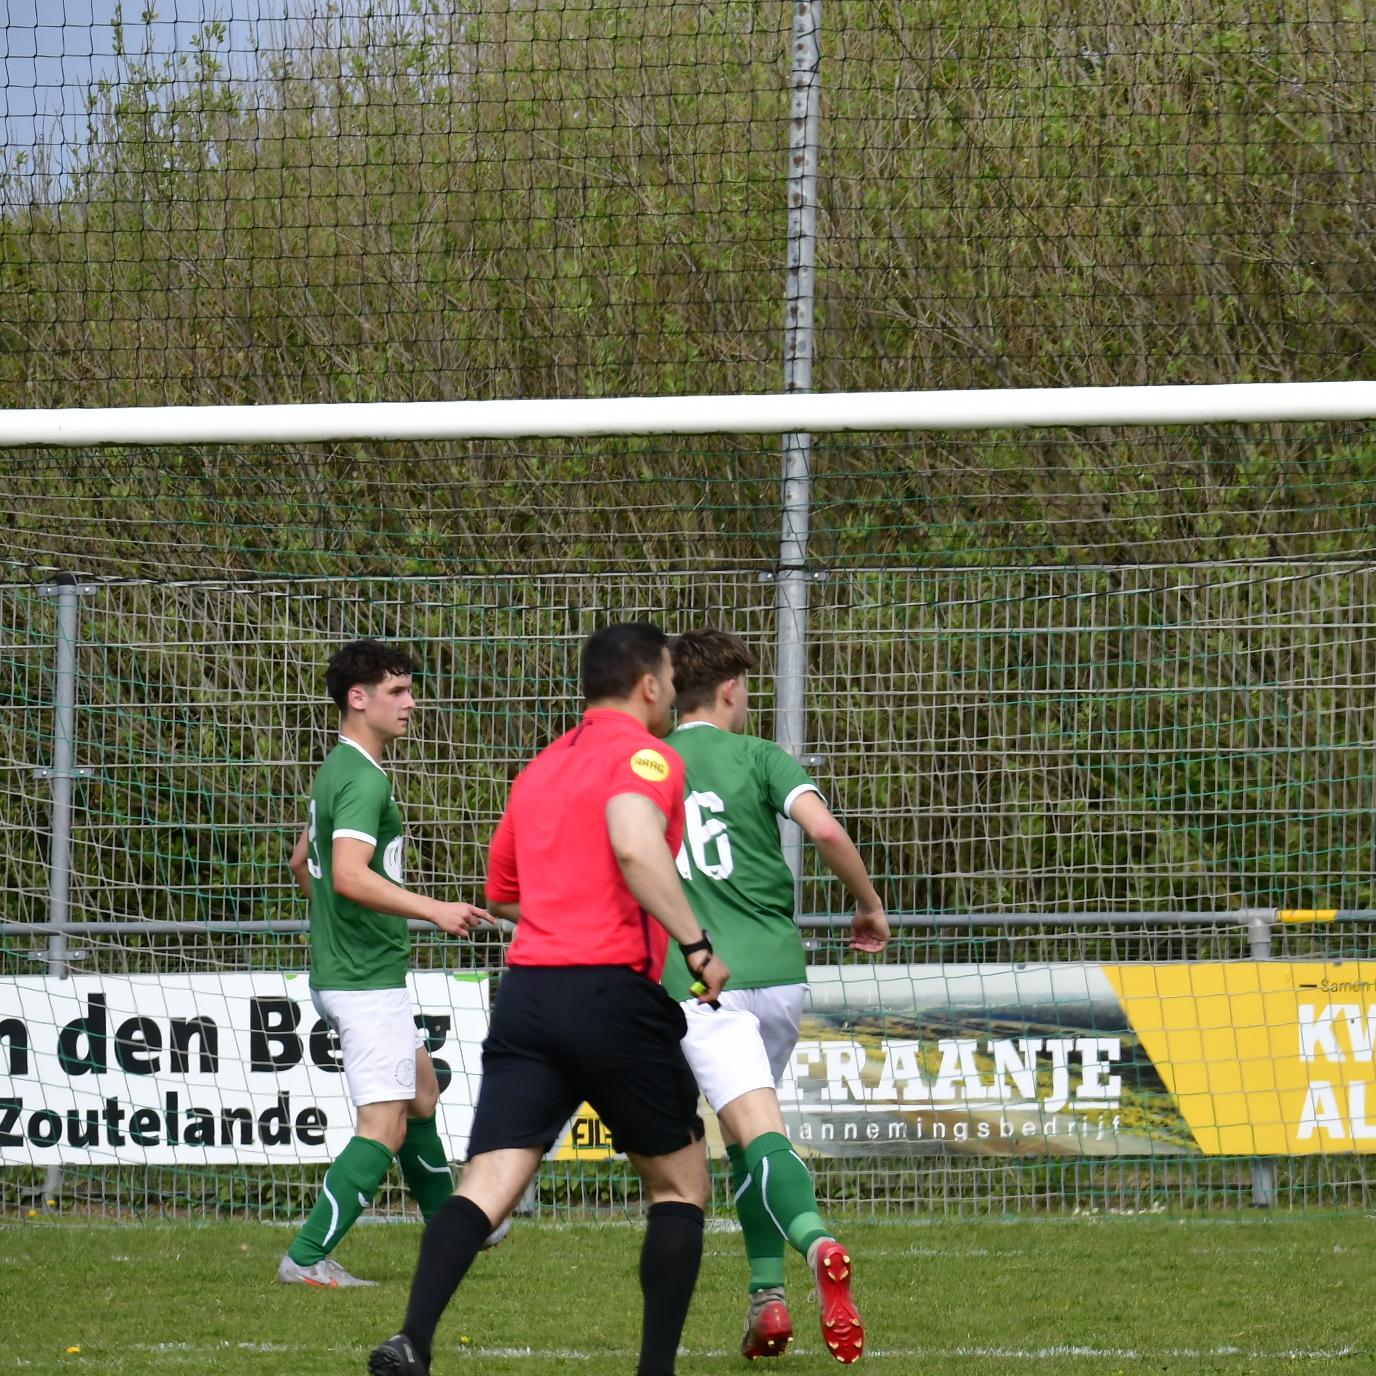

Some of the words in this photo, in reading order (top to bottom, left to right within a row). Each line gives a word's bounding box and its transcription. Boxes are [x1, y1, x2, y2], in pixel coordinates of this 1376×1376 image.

[57, 993, 219, 1076] den
[776, 1037, 1122, 1113] FRAANJE
[0, 1090, 328, 1149] Zoutelande
[785, 1115, 1121, 1142] annemingsbedrijf
